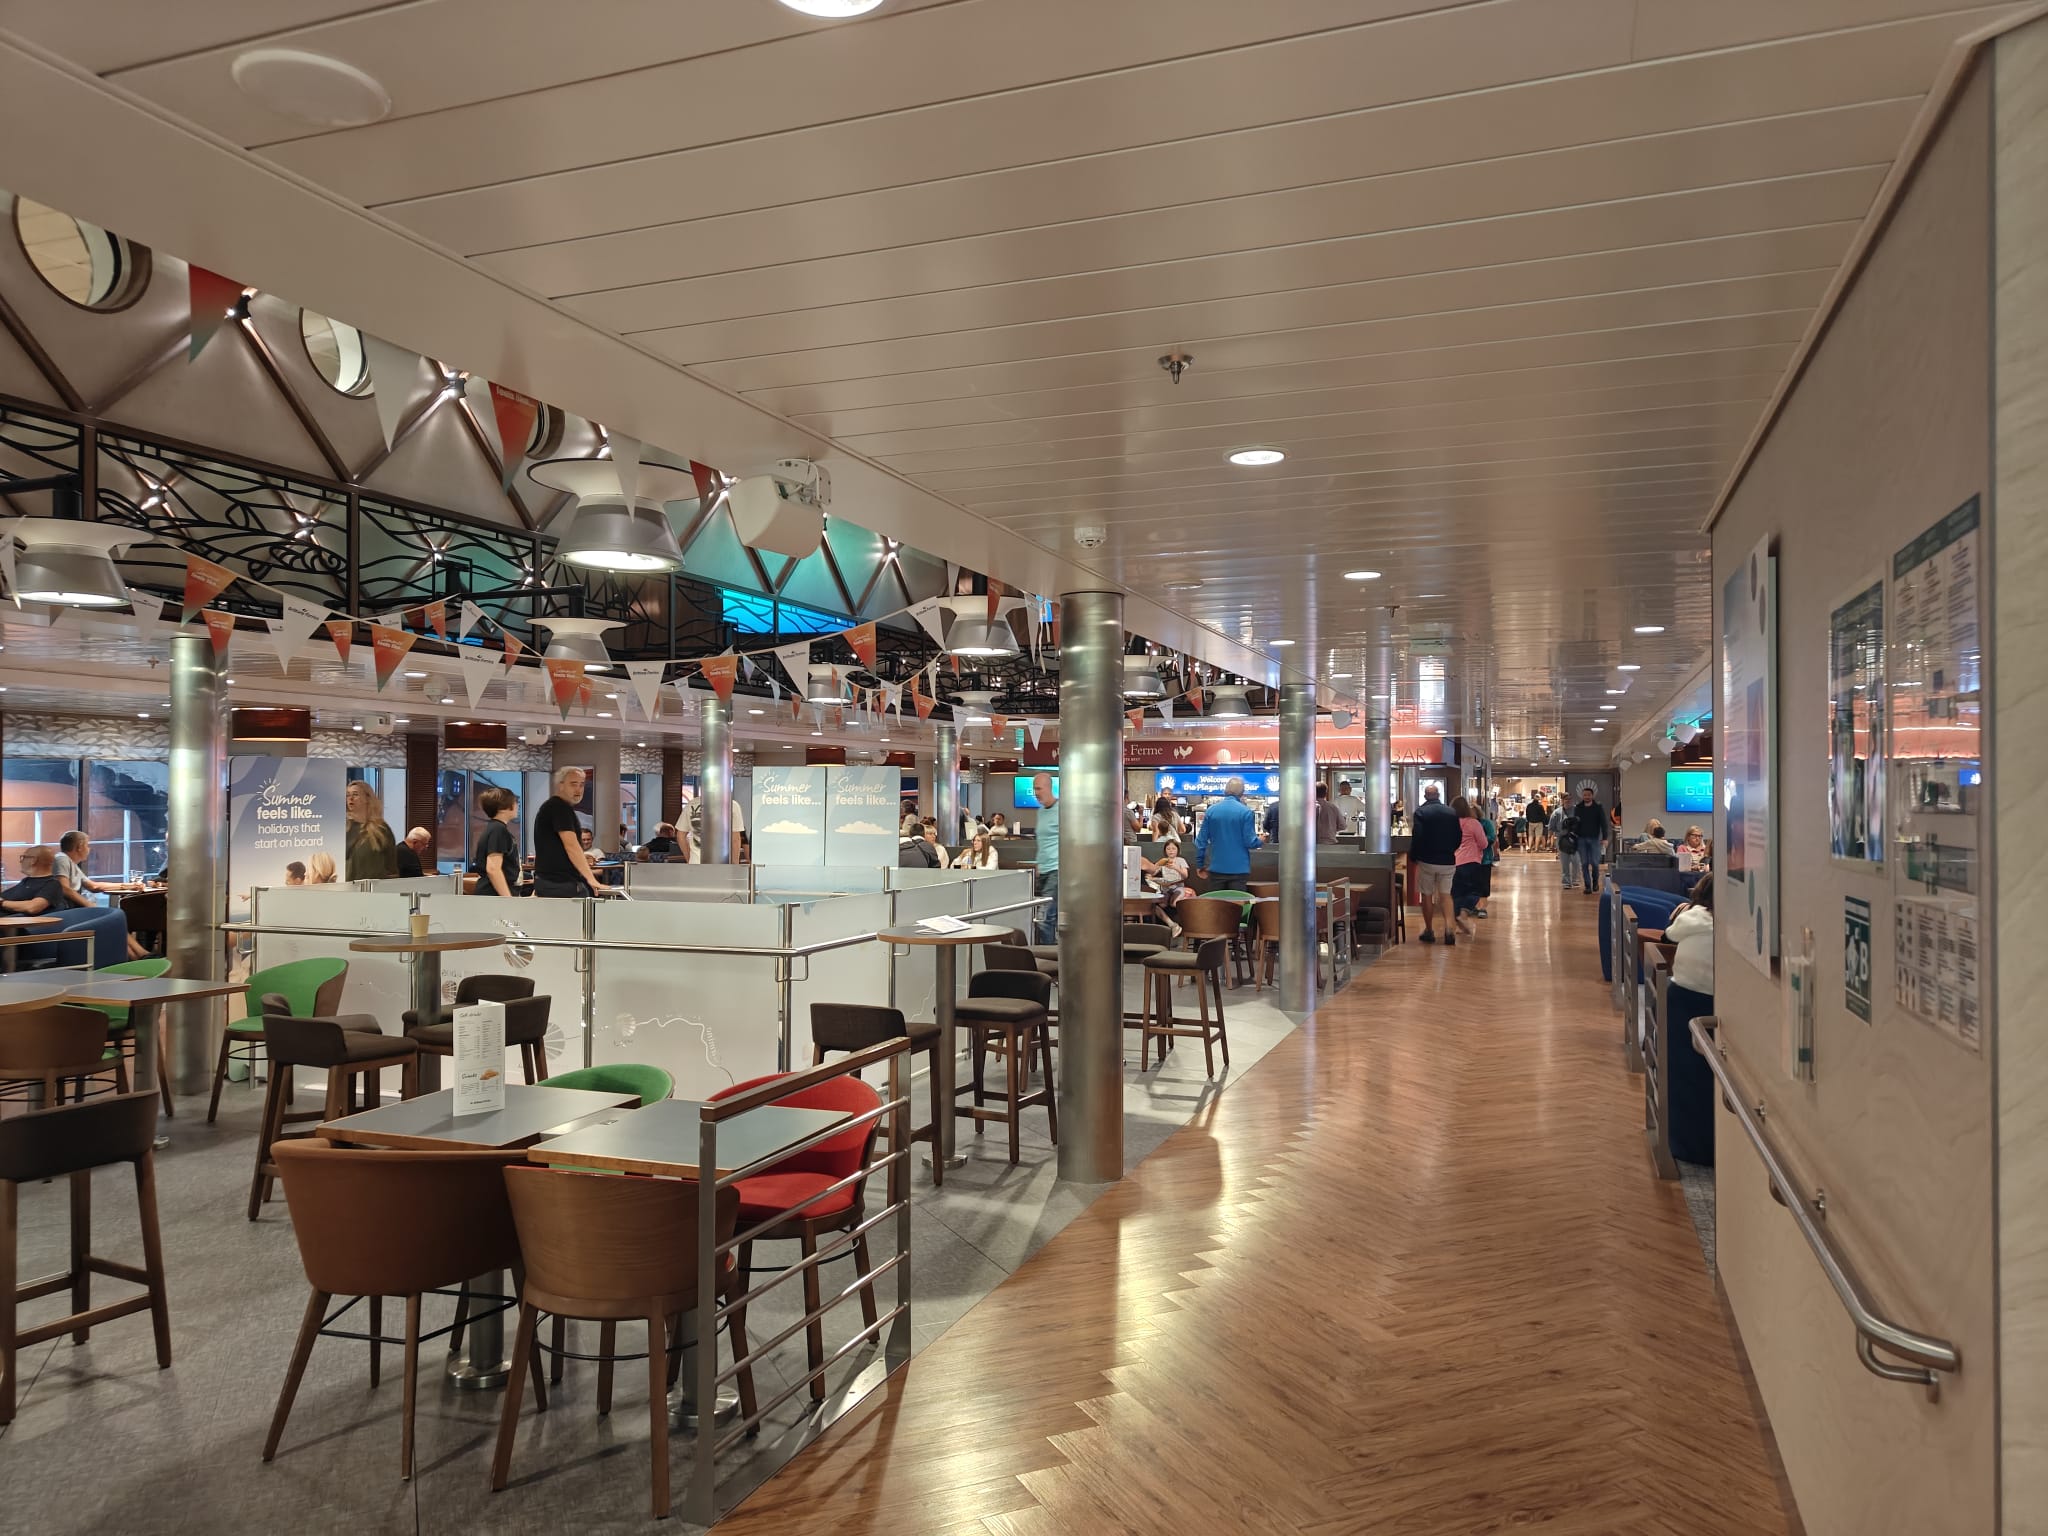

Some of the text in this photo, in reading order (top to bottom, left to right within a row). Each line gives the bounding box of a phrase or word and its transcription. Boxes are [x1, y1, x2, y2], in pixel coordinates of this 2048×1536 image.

[1131, 744, 1163, 755] Ferme
[1239, 749, 1427, 763] PLA MAY BAR
[763, 776, 812, 793] Summer
[837, 776, 887, 793] Summer
[262, 785, 316, 806] Summer
[762, 794, 789, 805] feels
[836, 794, 863, 805] feels
[257, 805, 323, 820] feels like...
[258, 822, 321, 836] holidays that
[254, 836, 323, 849] start on board
